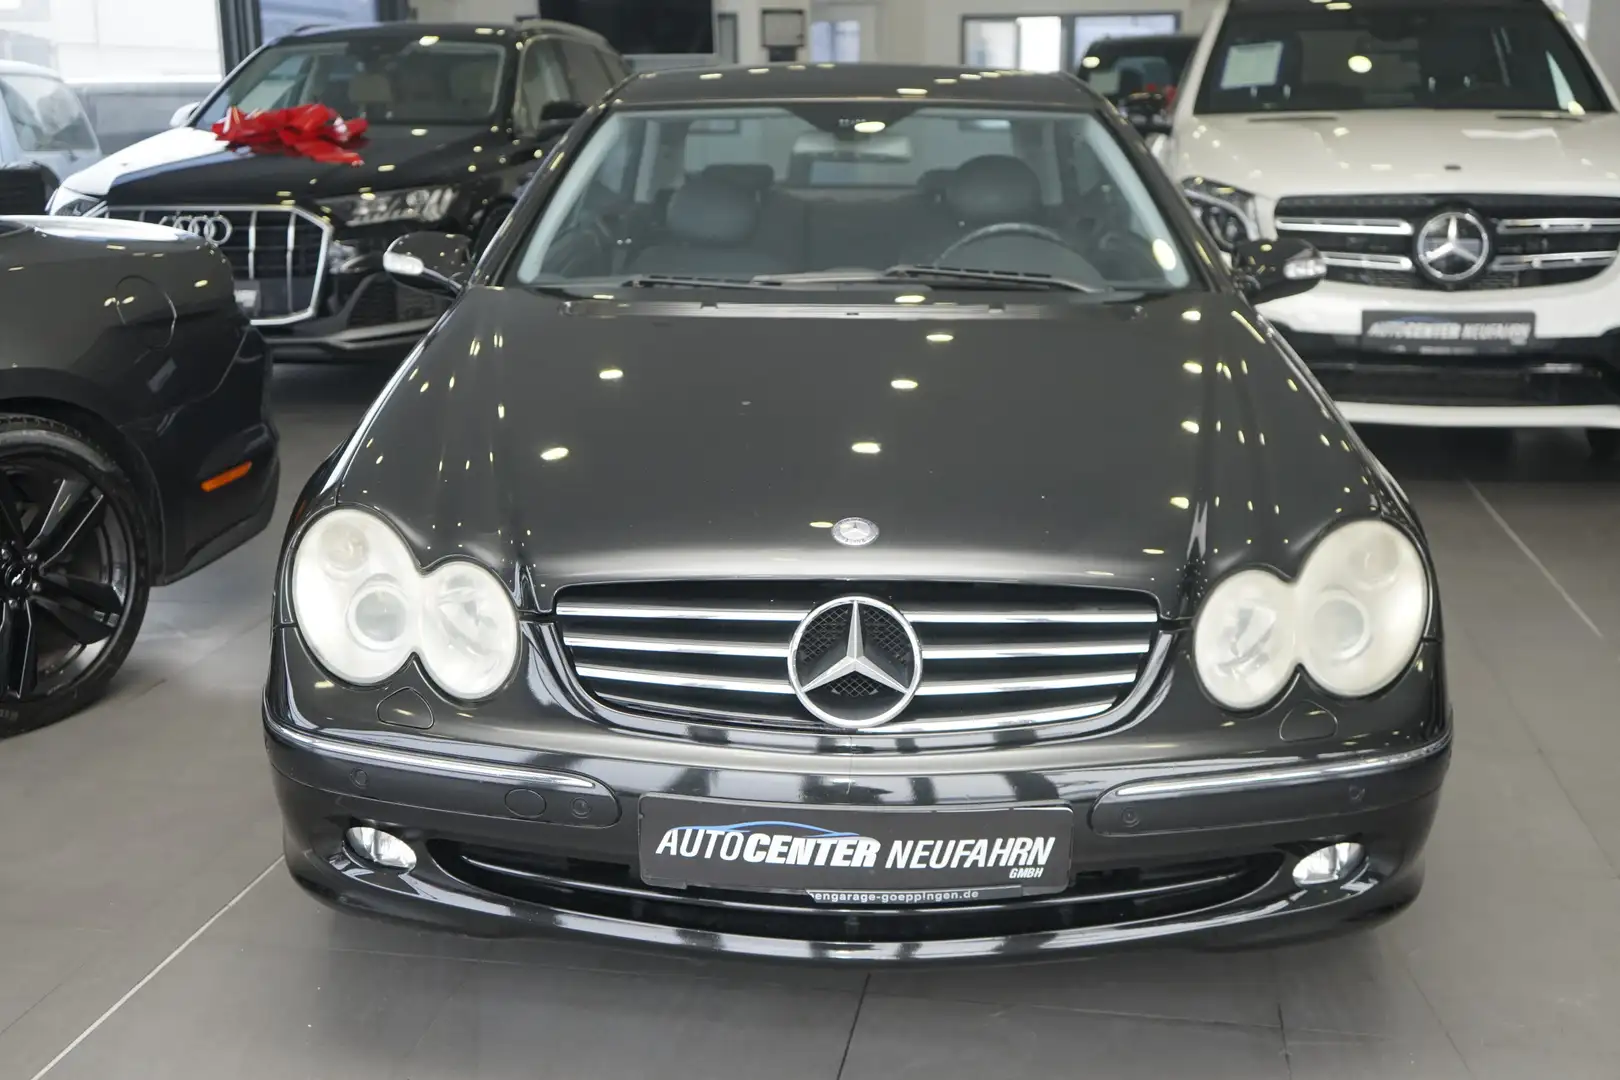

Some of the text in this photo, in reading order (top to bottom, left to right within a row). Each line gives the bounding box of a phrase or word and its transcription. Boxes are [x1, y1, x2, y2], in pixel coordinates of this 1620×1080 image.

[656, 828, 1056, 869] AUTOCENTER NEUFAHRN
[1009, 867, 1044, 879] GMBH
